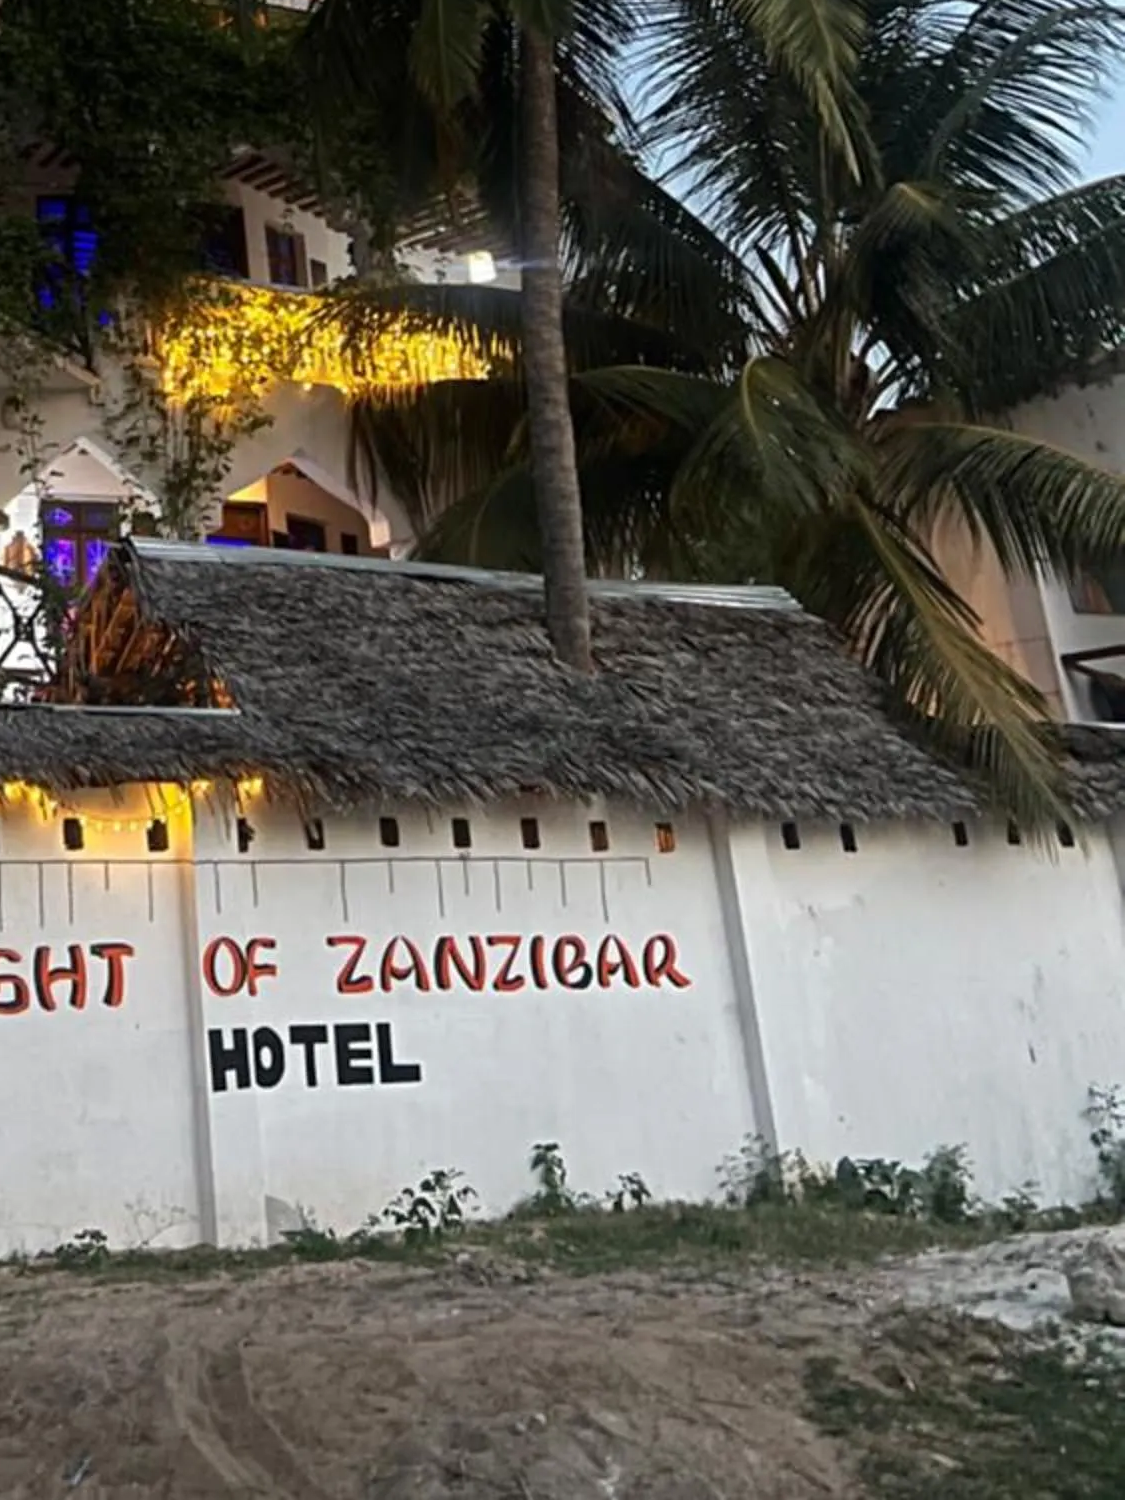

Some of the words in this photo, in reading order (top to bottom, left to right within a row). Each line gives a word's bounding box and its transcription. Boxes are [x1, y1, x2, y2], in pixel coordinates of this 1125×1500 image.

[202, 936, 277, 997] OF
[325, 934, 691, 995] ZANZIBAR
[208, 1021, 423, 1093] HOTEL
